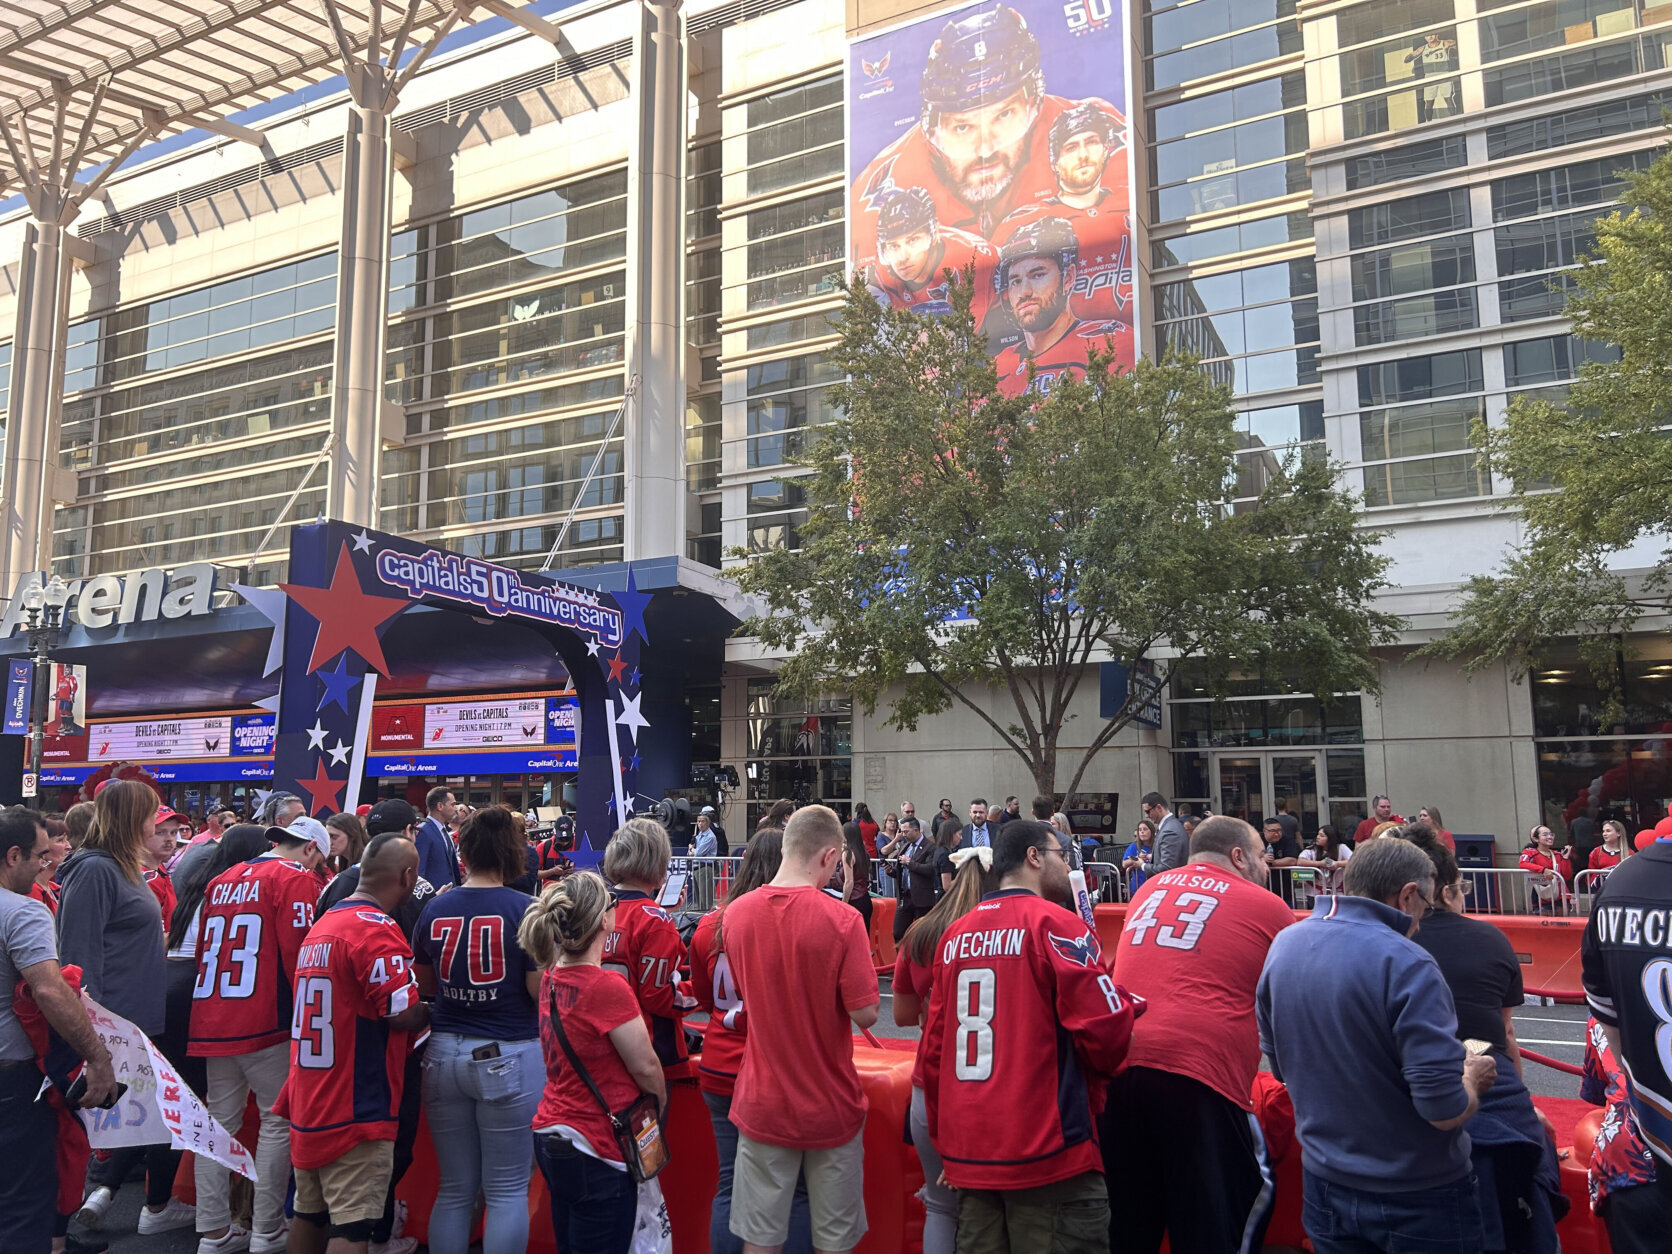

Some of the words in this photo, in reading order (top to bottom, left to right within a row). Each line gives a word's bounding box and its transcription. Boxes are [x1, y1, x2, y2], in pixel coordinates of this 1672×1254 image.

[1064, 0, 1111, 28] 50
[974, 41, 987, 57] 8
[966, 74, 1002, 92] CCM
[384, 554, 472, 595] capitals
[0, 563, 217, 639] Arena
[510, 590, 620, 641] anniversary
[455, 723, 478, 732] OPENING
[479, 723, 496, 731] NIGHT
[459, 709, 478, 721] DEVILS
[482, 707, 509, 720] CAPITALS
[548, 710, 574, 719] OPENI
[554, 718, 574, 727] NIGH
[135, 724, 151, 737] DEVILS
[156, 723, 181, 736] CAPITALS
[234, 725, 275, 738] OPENING
[240, 736, 269, 747] NIGHT
[482, 735, 503, 743] GEICO
[211, 880, 260, 905] CHARA
[1157, 873, 1230, 894] WILSON
[1124, 889, 1220, 951] 43
[1597, 906, 1672, 948] OVEC
[192, 912, 263, 999] 33
[297, 942, 333, 970] WILSON
[430, 914, 506, 985] 70
[943, 928, 1026, 965] OVECHKIN
[369, 955, 405, 985] 43
[640, 955, 669, 988] 70
[442, 985, 498, 1002] HOLTBY
[1096, 974, 1123, 1014] 8
[955, 967, 997, 1082] 8
